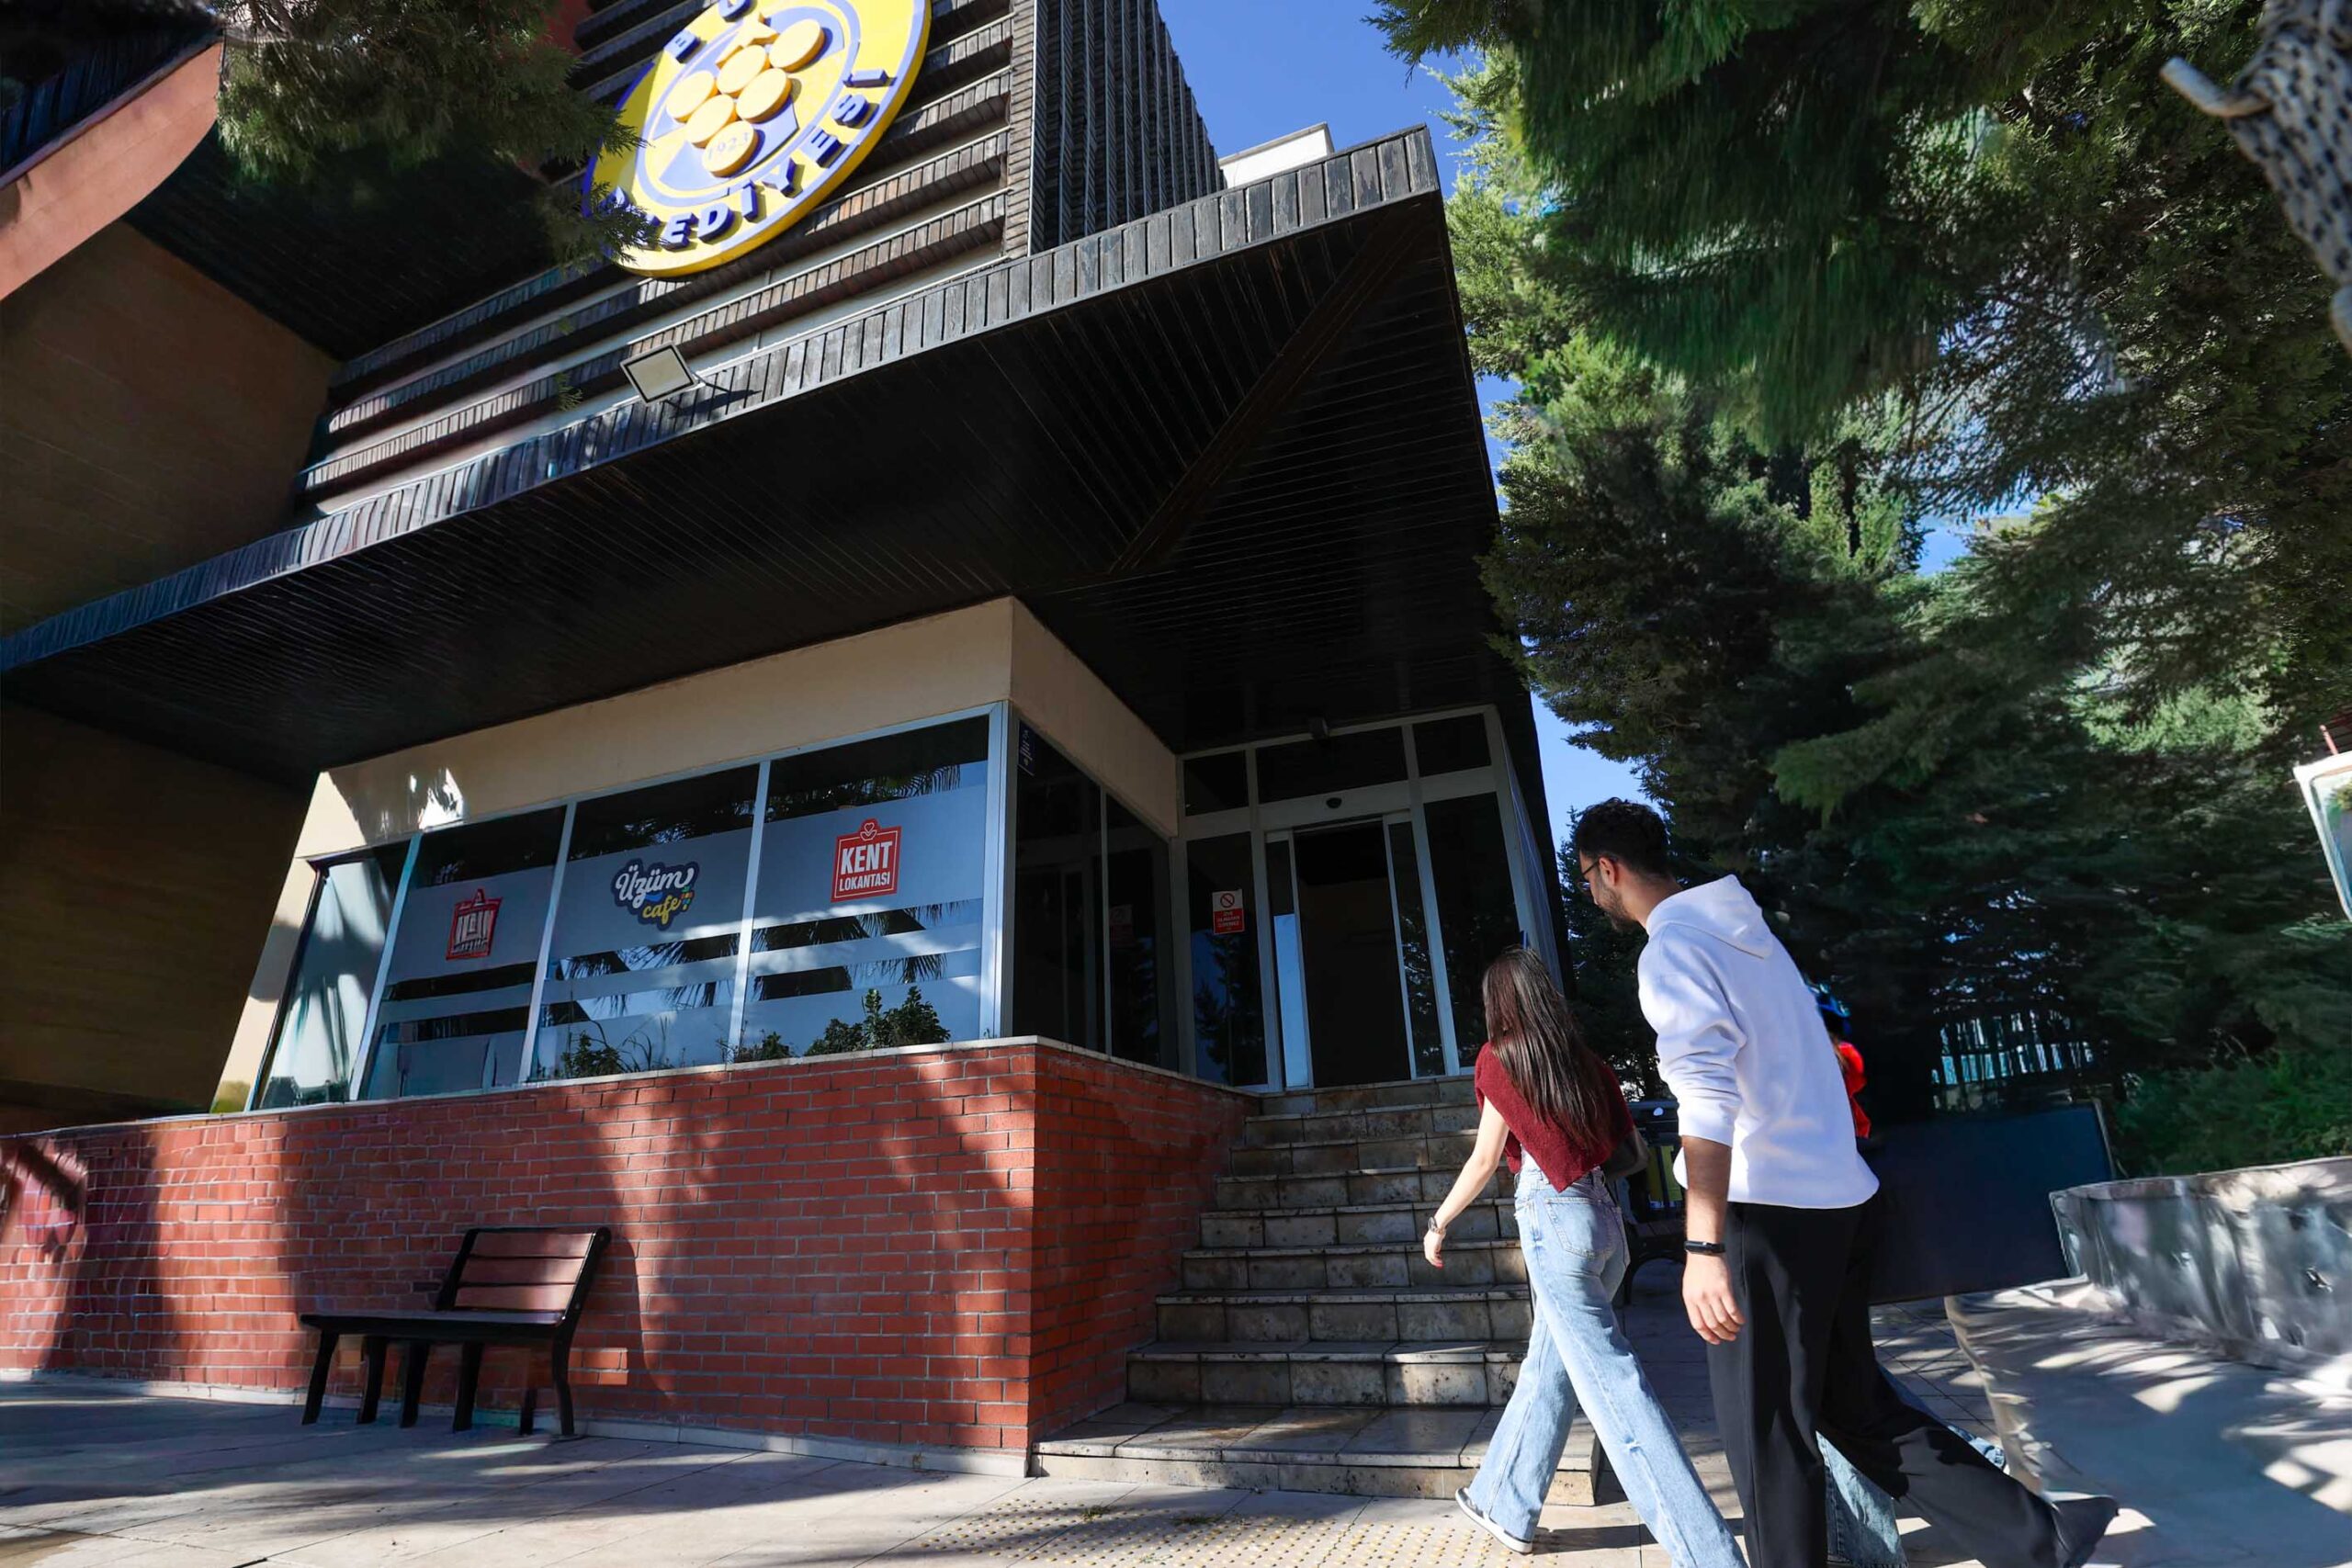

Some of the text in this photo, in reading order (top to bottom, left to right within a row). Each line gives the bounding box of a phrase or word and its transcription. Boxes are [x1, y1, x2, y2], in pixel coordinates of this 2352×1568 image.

[840, 840, 893, 875] KENT
[615, 863, 695, 909] Üzüm
[839, 871, 891, 892] LOKANTASI
